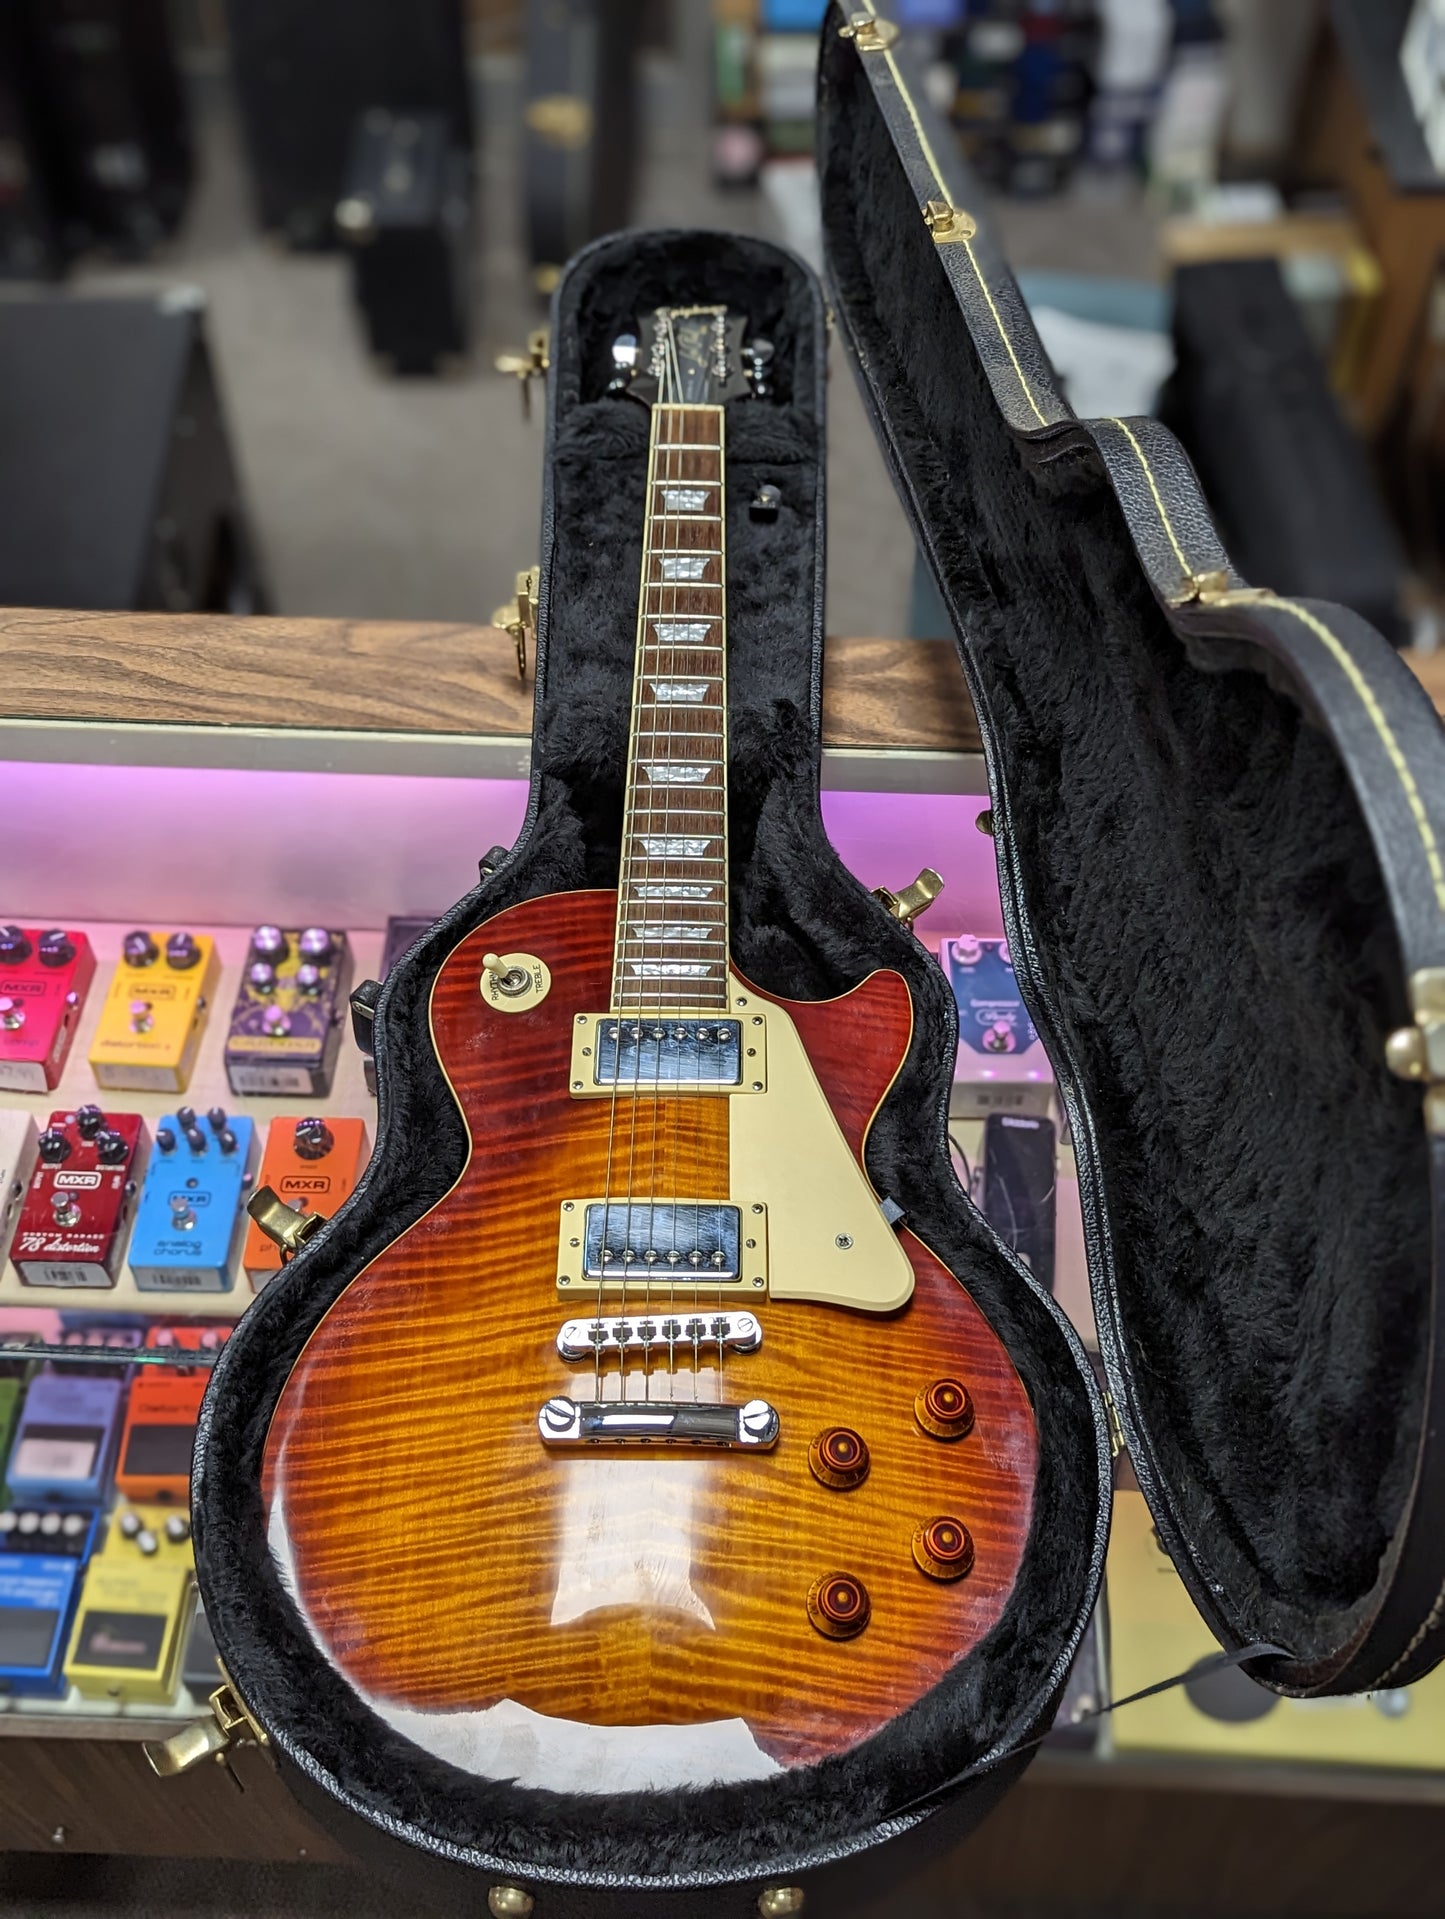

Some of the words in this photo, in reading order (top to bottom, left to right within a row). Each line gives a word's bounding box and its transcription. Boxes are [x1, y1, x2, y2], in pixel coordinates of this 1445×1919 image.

[532, 963, 544, 994] TREBLE
[58, 1175, 97, 1185] MXR
[285, 1180, 325, 1190] MXR
[43, 1237, 100, 1254] distortion
[156, 1241, 203, 1250] analog
[153, 1247, 203, 1256] chorus
